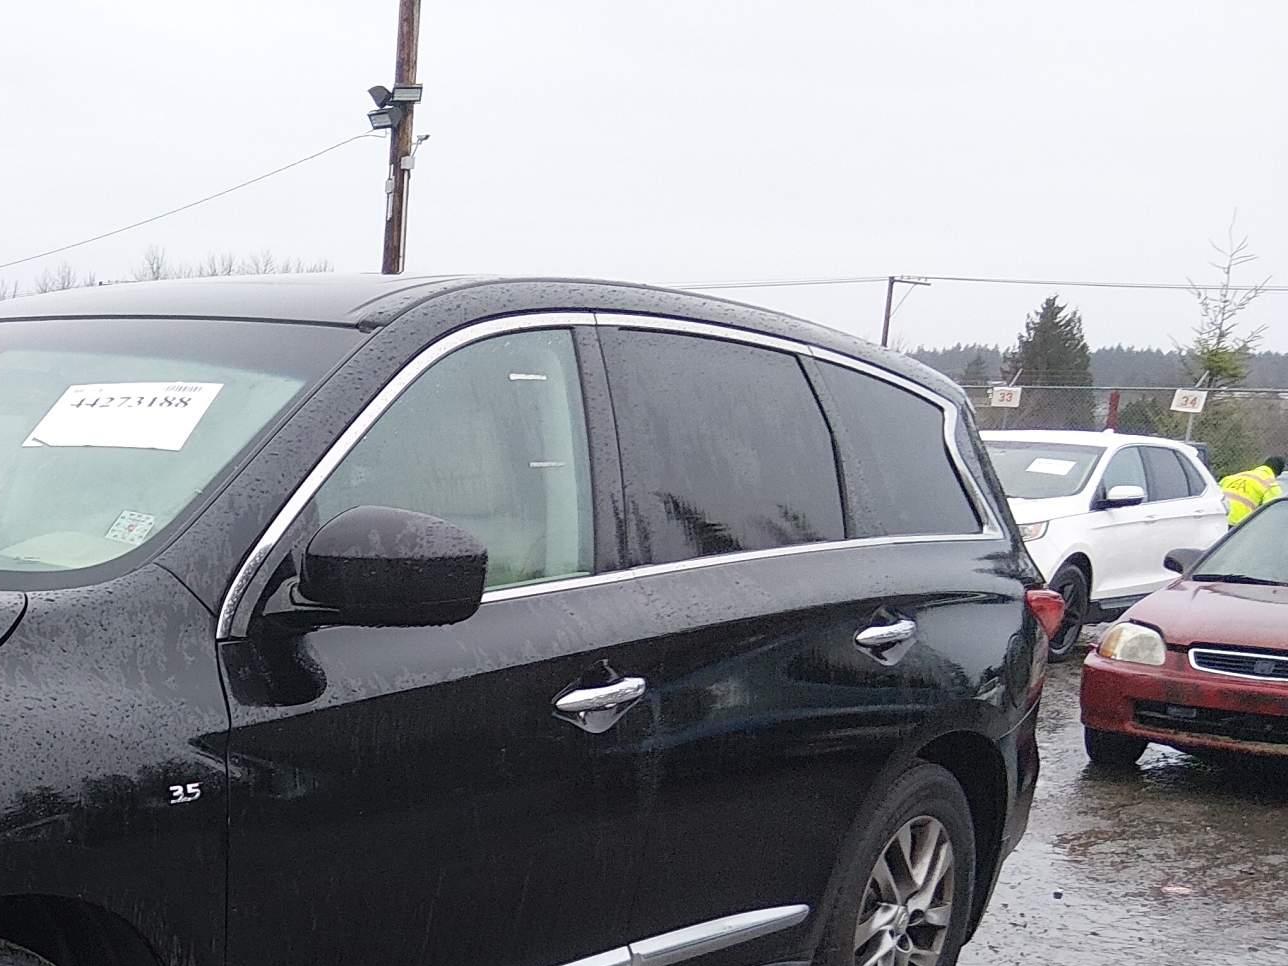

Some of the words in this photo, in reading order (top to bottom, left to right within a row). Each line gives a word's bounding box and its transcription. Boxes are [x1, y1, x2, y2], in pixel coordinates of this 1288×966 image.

[70, 396, 192, 408] 44273188
[998, 392, 1014, 402] 33
[1181, 395, 1198, 408] 34
